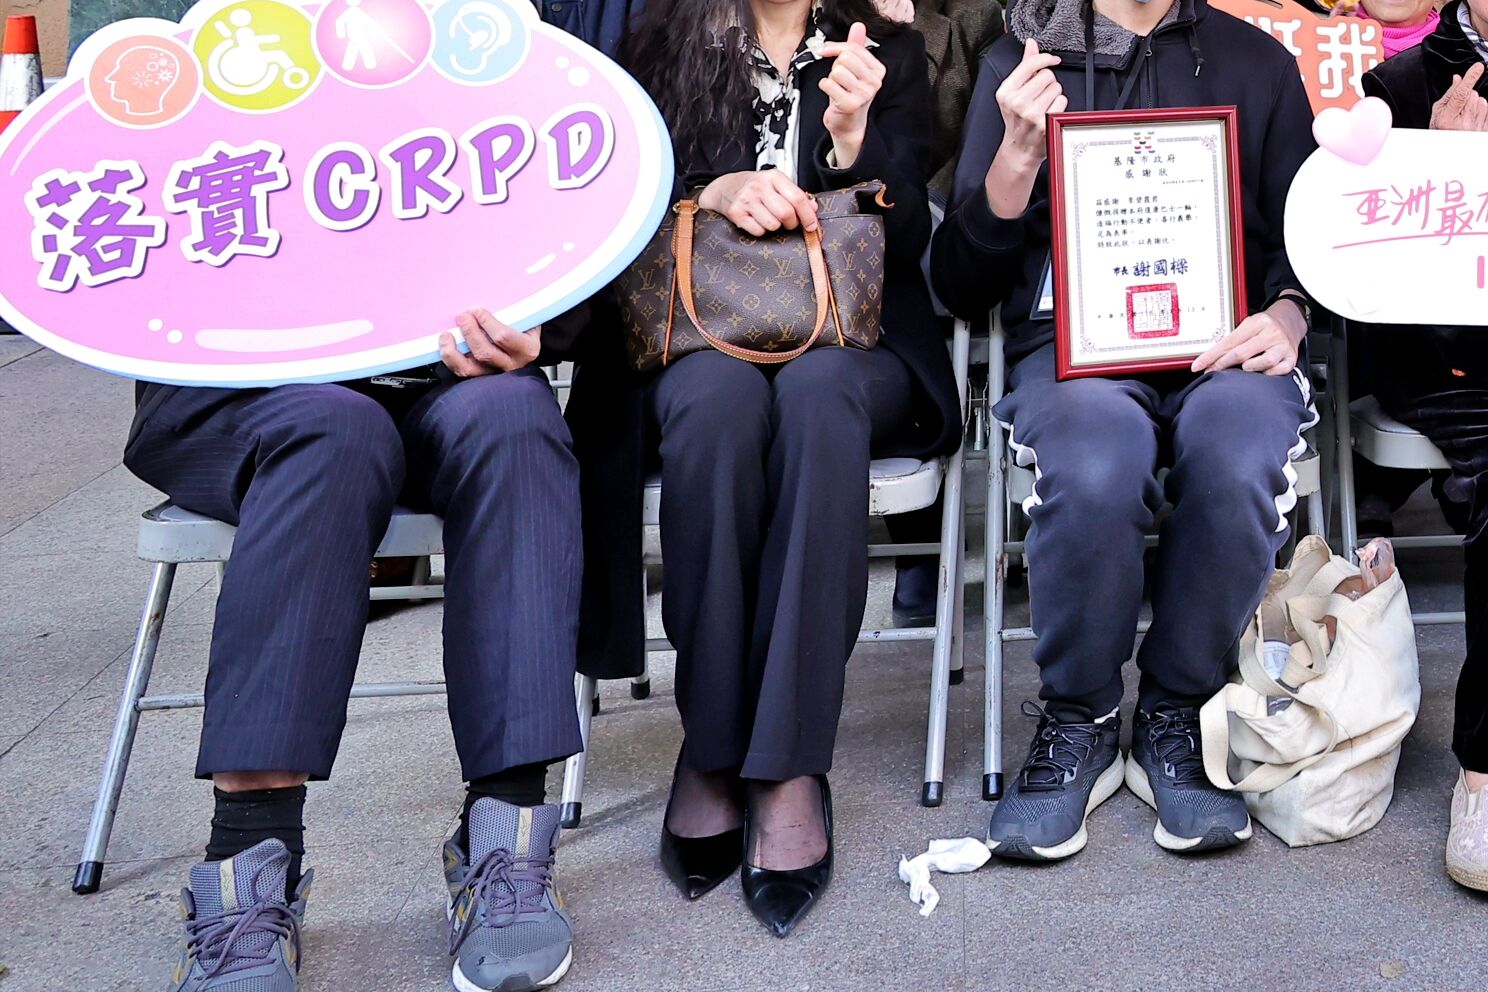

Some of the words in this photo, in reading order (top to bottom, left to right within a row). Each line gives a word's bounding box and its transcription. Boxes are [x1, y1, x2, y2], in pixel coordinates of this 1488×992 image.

[1114, 154, 1175, 166] 基隆市政府
[1125, 168, 1168, 179] 感謝狀
[33, 144, 283, 286] 落實
[308, 106, 609, 226] CRPD
[1113, 266, 1129, 276] 市長
